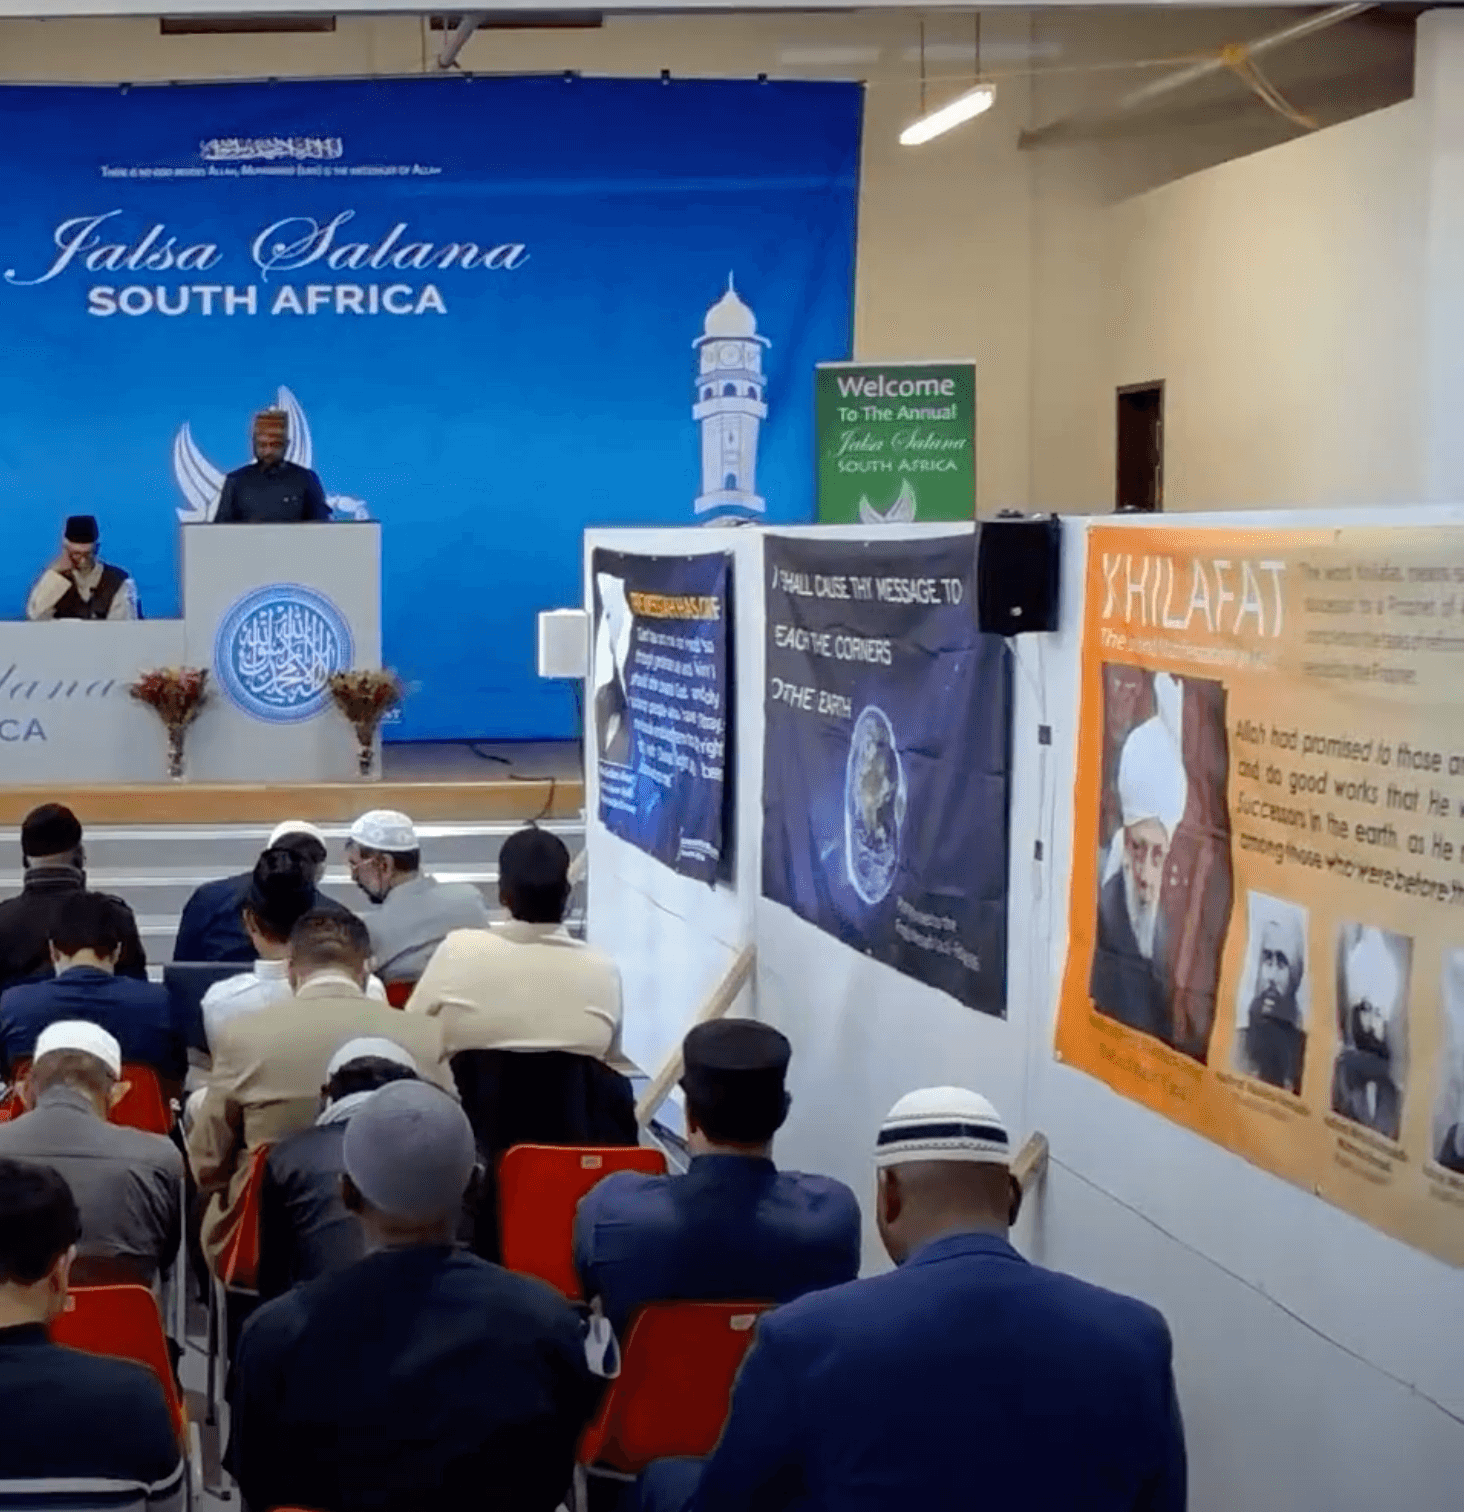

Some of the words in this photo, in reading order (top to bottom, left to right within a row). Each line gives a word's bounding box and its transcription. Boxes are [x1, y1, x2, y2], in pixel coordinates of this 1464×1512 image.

[3, 209, 223, 286] Jalsa
[252, 209, 531, 283] Salana
[87, 284, 257, 317] SOUTH
[271, 283, 448, 316] AFRICA
[837, 374, 955, 398] Welcome
[837, 407, 858, 422] To
[861, 405, 893, 422] The
[897, 403, 958, 421] Annual
[837, 459, 893, 473] SOUTH
[897, 458, 958, 472] AFRICA
[814, 574, 851, 599] CAUSE
[849, 576, 873, 600] THY
[875, 577, 942, 604] MESSAGE
[941, 578, 963, 606] TO
[835, 635, 892, 666] CORNERS
[1235, 719, 1266, 745] Allah
[1270, 724, 1298, 751] had
[1302, 730, 1372, 763] promised
[1377, 738, 1392, 766] to
[1396, 742, 1442, 773] those
[1238, 759, 1260, 782] and
[1266, 763, 1282, 786] do
[1289, 770, 1328, 795] good
[1334, 779, 1379, 805] works
[1387, 783, 1419, 812] that
[1428, 787, 1450, 818] He
[1237, 790, 1307, 829] Successors
[1310, 808, 1322, 832] in
[1326, 811, 1349, 839] the
[1407, 832, 1425, 855] as
[1431, 831, 1454, 862] He
[1325, 850, 1355, 878] who
[1356, 863, 1394, 889] were
[1394, 866, 1449, 902] before
